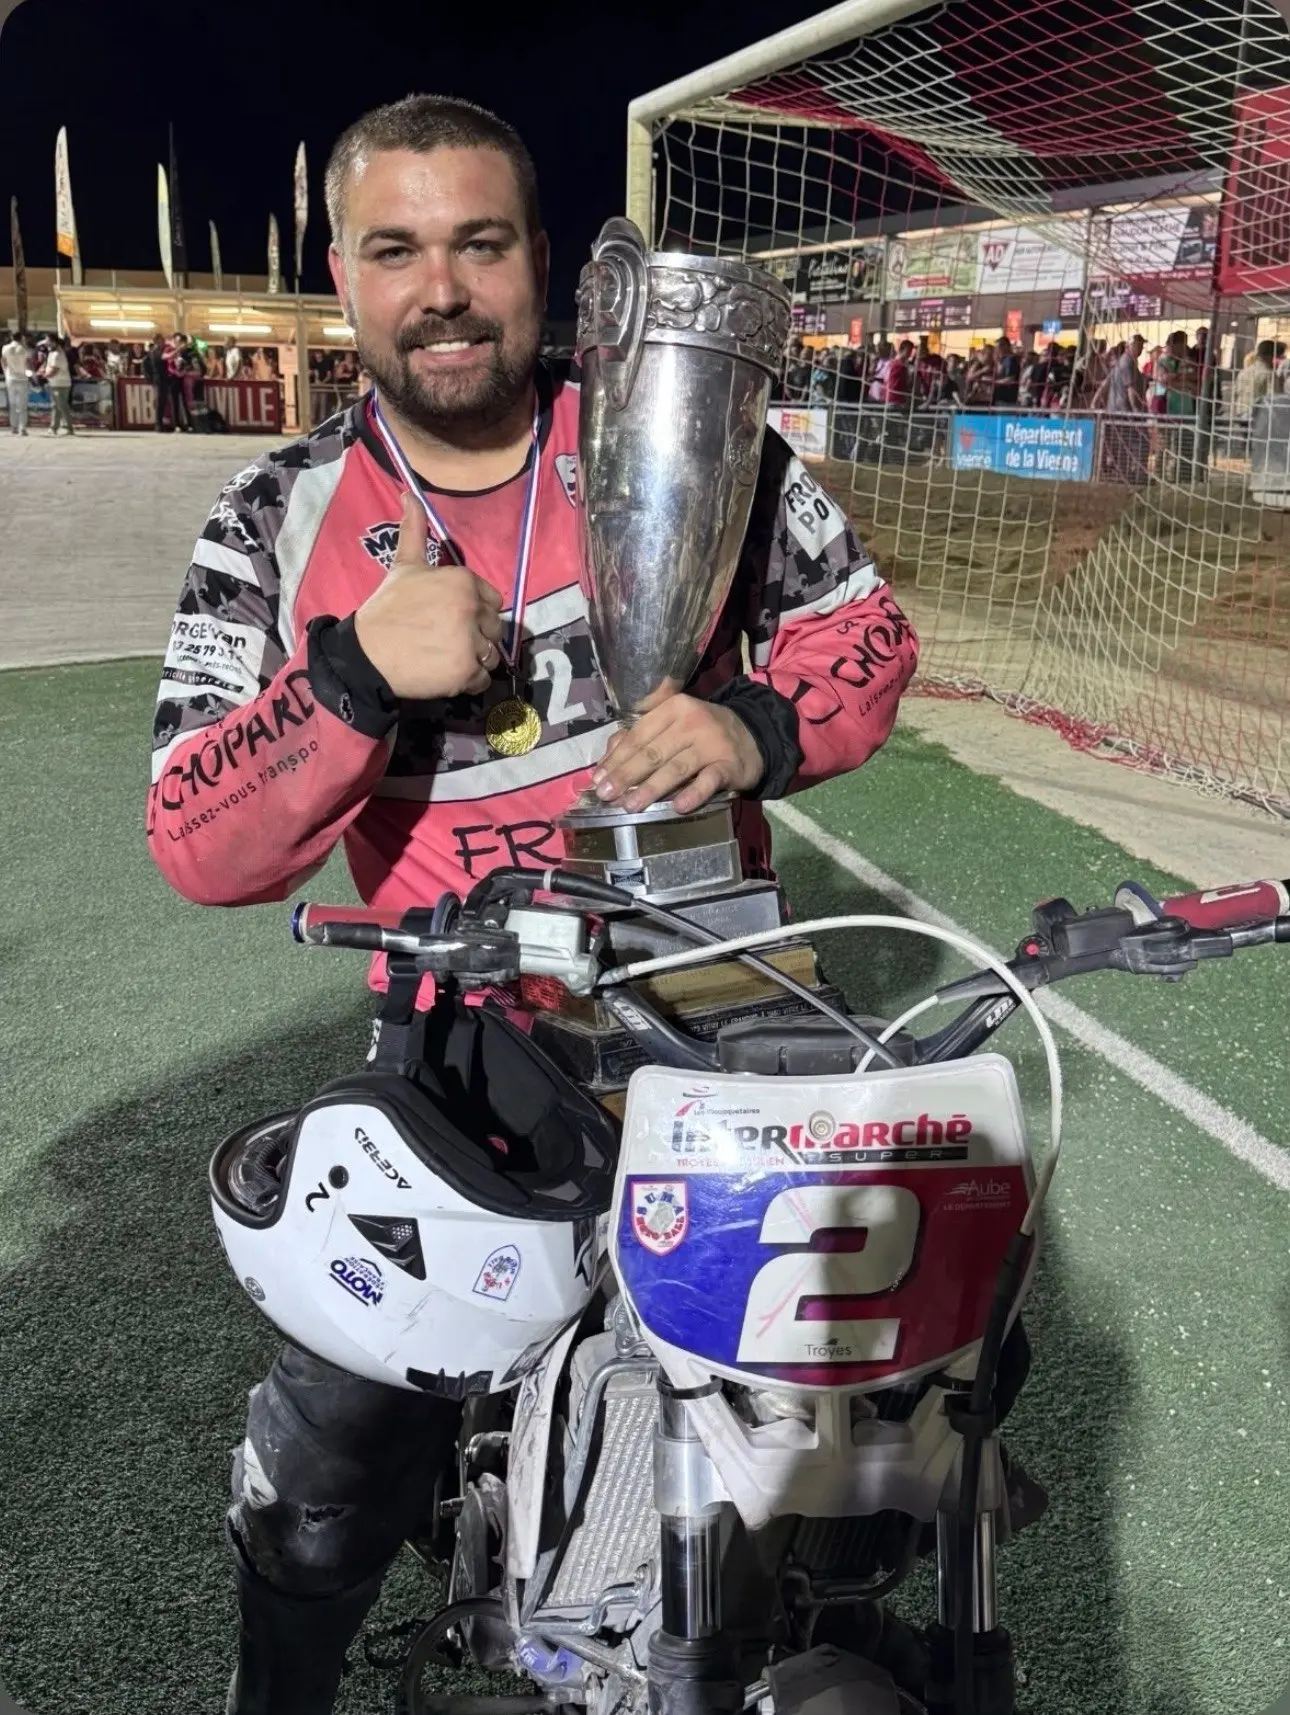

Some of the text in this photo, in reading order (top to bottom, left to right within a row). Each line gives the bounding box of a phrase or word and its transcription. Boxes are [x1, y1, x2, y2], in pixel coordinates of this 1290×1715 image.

[1004, 422, 1083, 448] Département
[1006, 449, 1079, 472] de la Vienne
[530, 648, 587, 726] 2
[305, 1181, 331, 1213] 2
[967, 1179, 1011, 1197] Aube
[330, 1259, 383, 1306] MOTO
[735, 1184, 921, 1363] 2
[804, 1343, 853, 1359] Troyes
